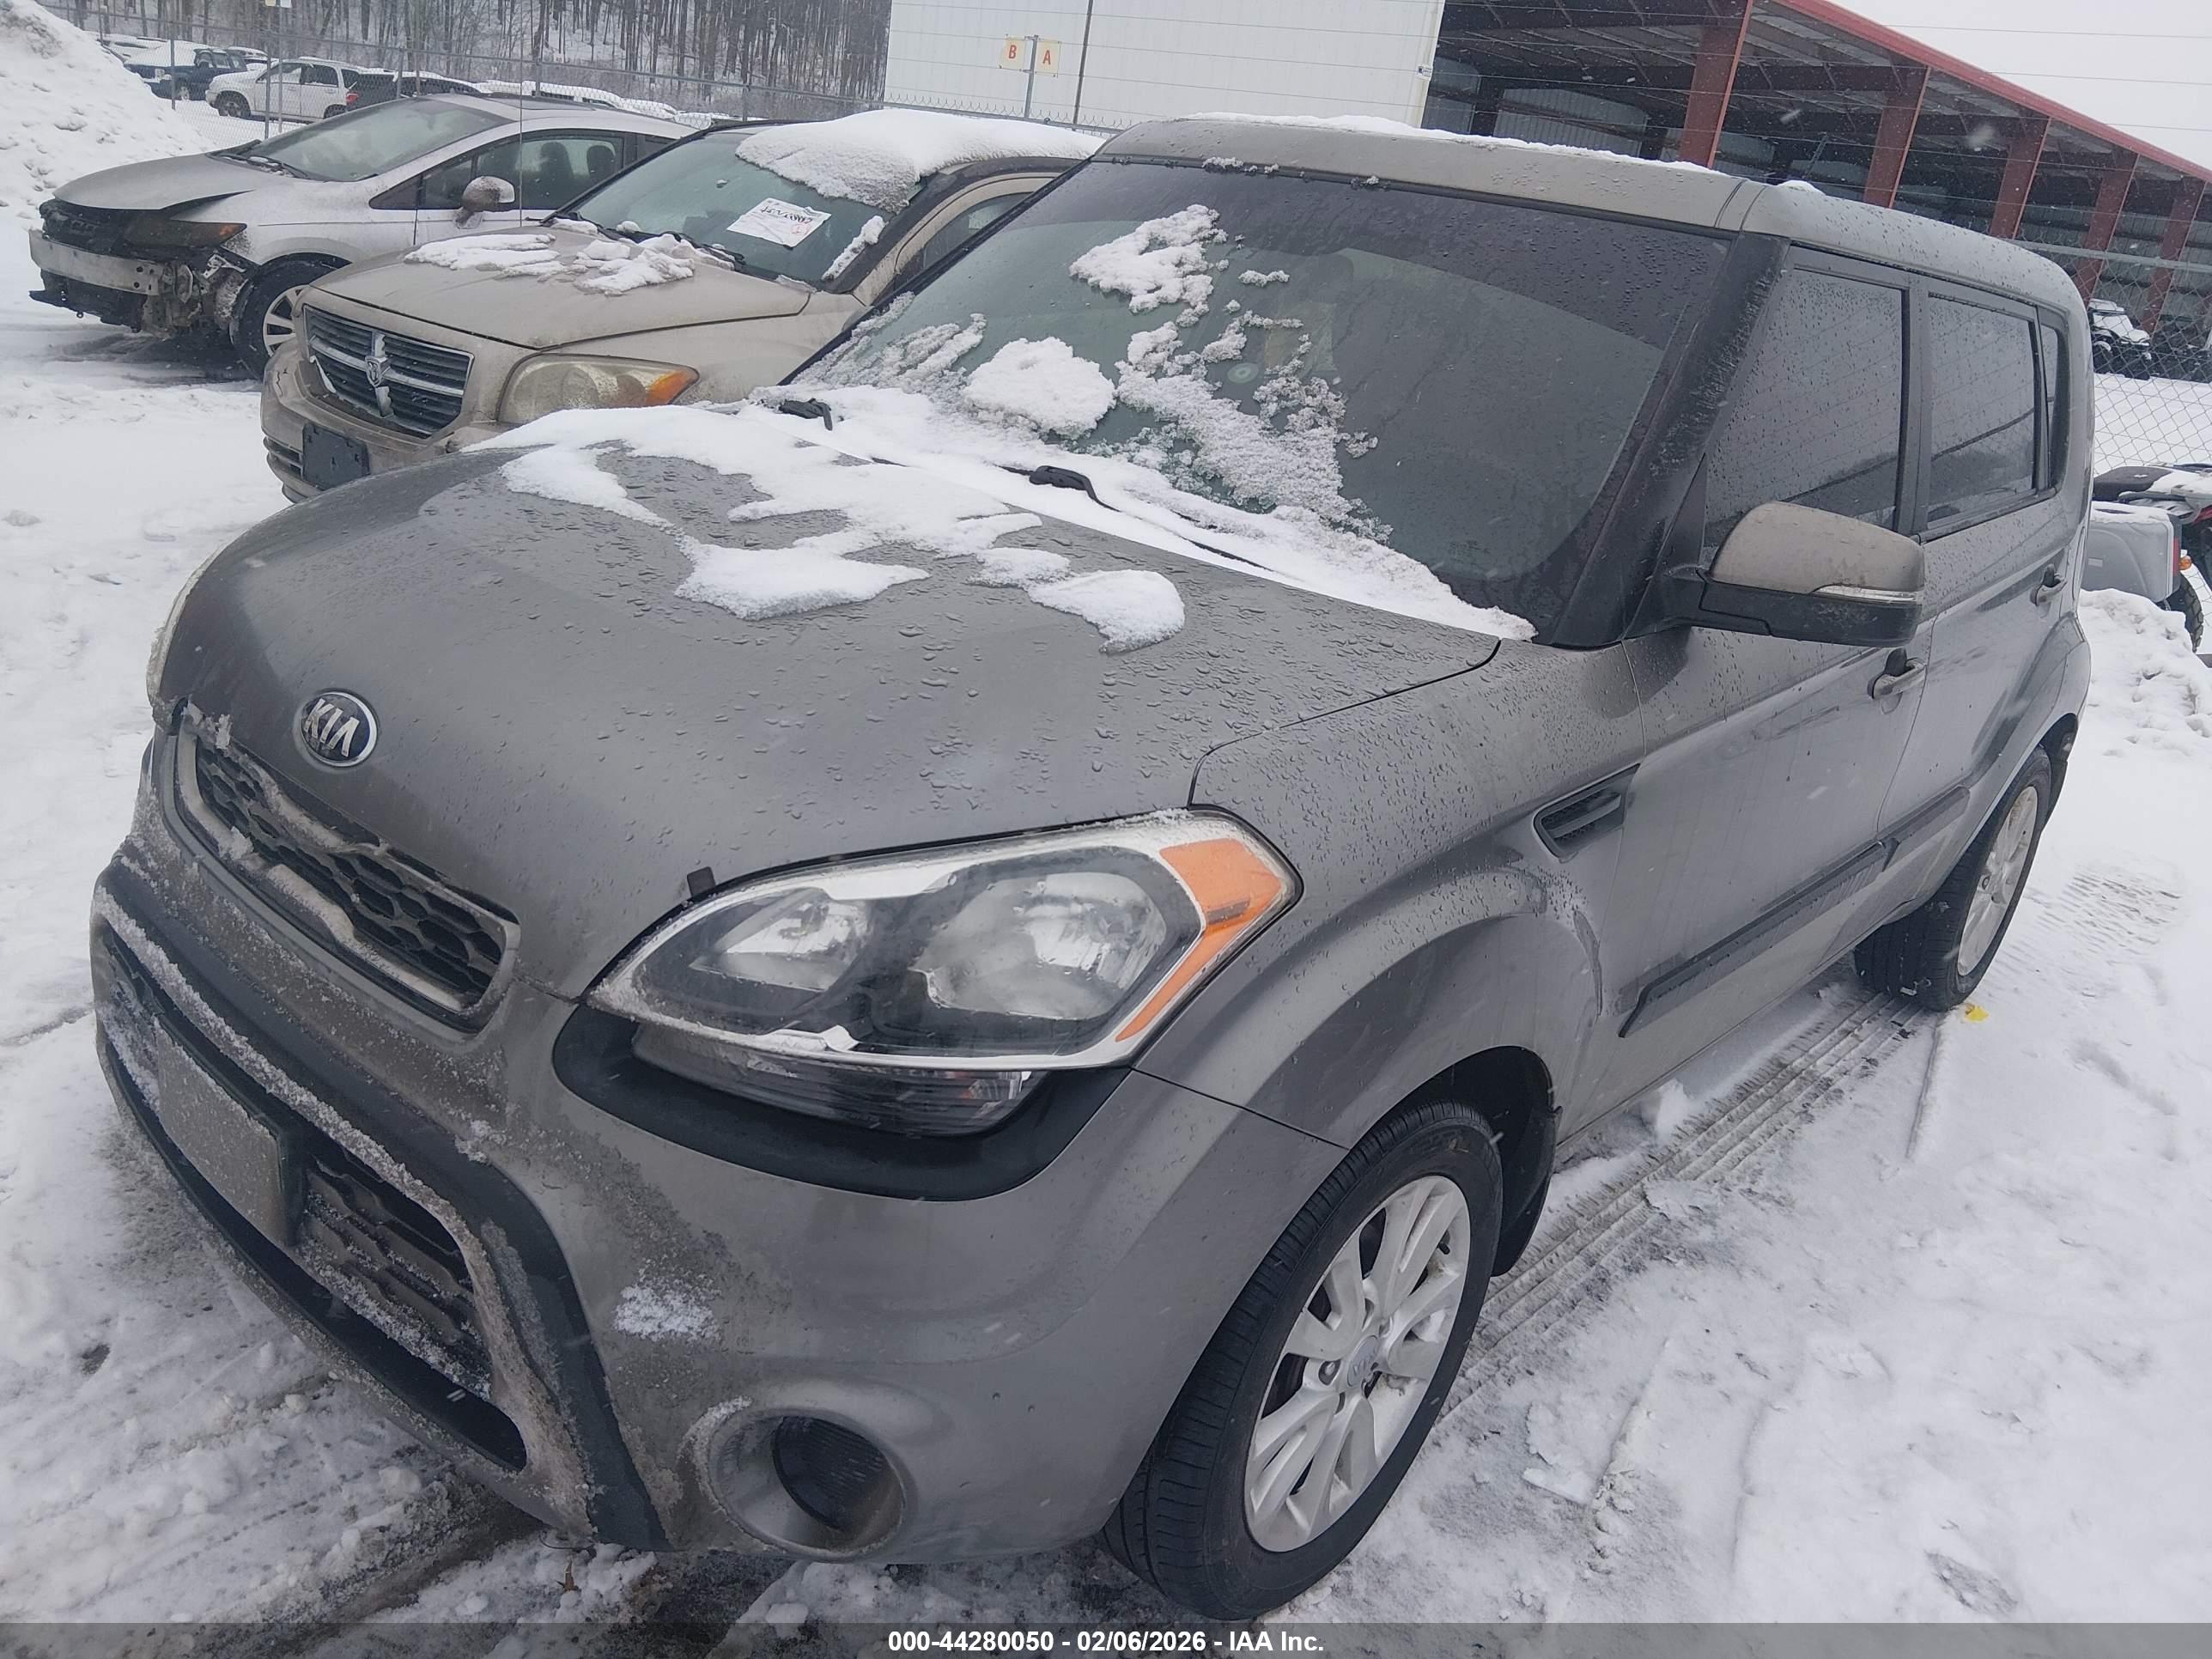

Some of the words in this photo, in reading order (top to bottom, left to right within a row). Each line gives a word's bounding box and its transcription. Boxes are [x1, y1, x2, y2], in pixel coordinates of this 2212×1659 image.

[1008, 45, 1018, 59] B
[1042, 50, 1051, 65] A
[303, 698, 361, 757] KIA
